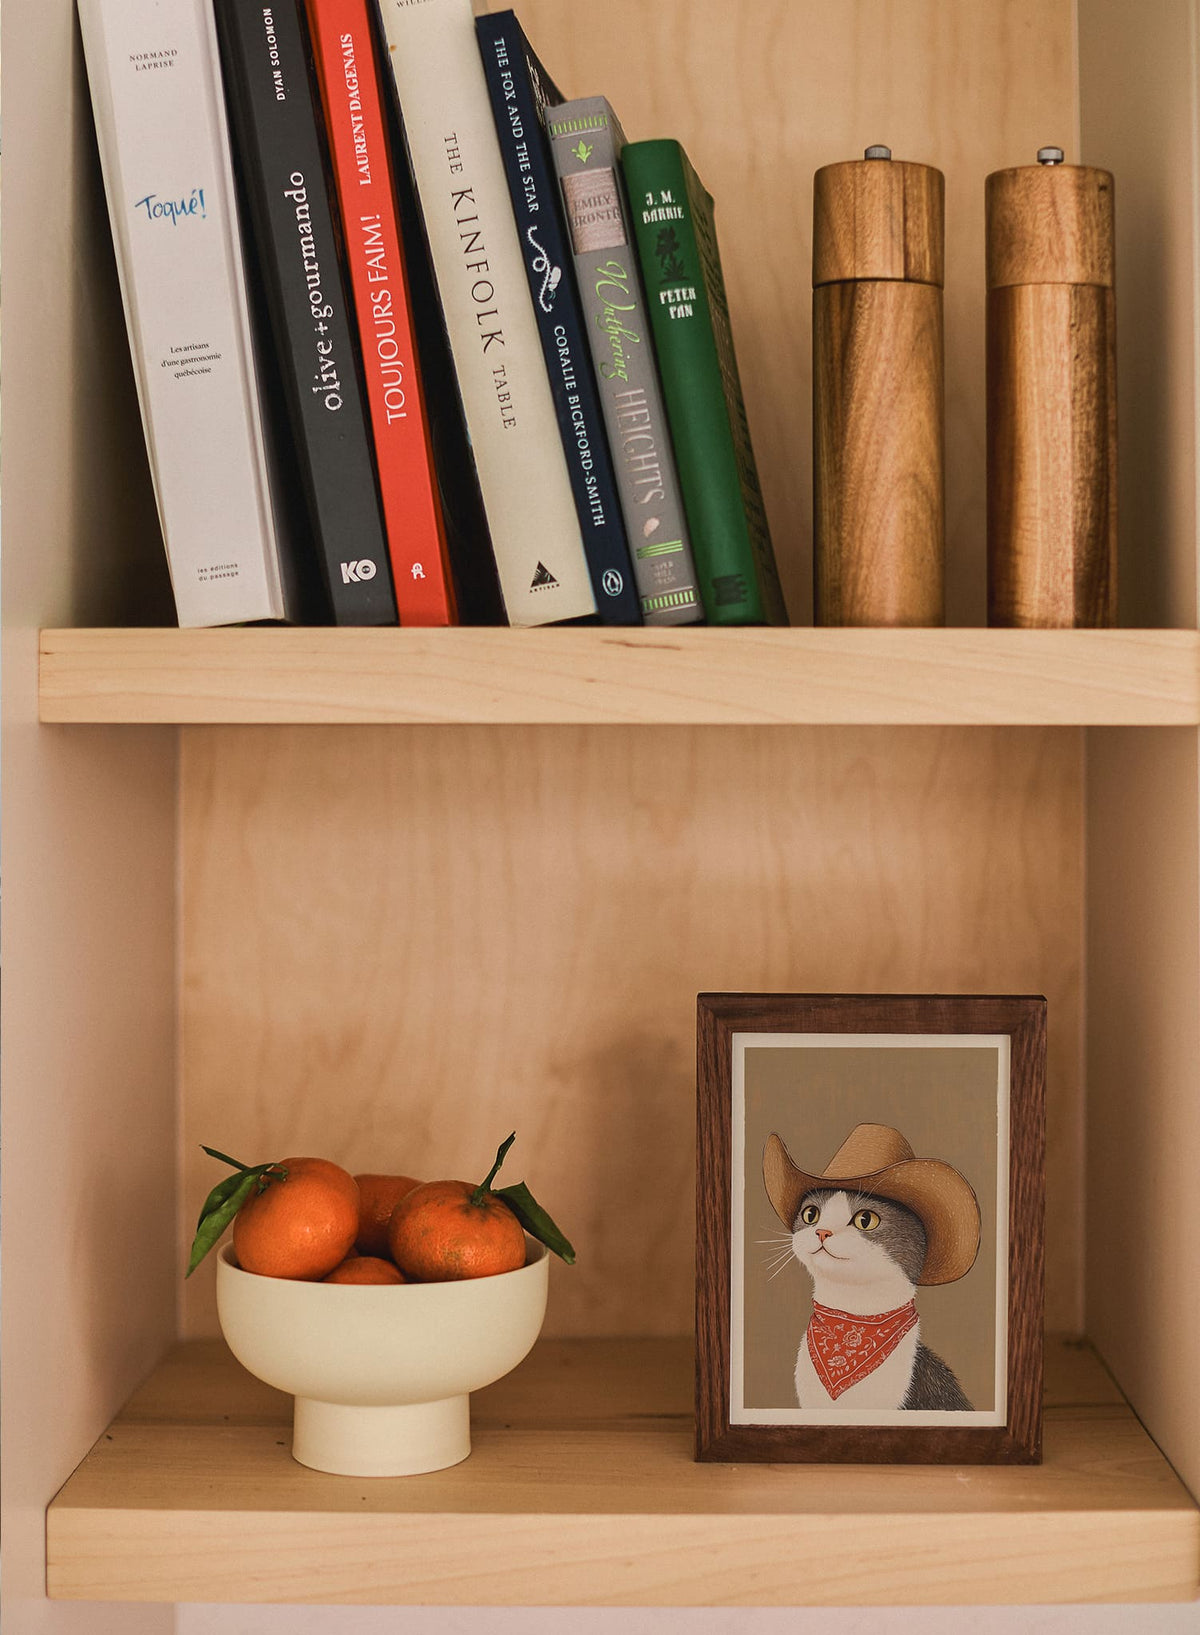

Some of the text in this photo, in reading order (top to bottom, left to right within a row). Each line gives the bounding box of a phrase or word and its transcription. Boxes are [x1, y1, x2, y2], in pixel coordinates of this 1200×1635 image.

[129, 49, 178, 62] NORMAND
[262, 8, 286, 101] DYAN SOLOMON
[135, 60, 174, 71] LAPRISE
[340, 33, 372, 186] LAURENT DAGENAIS
[494, 37, 540, 213] THE FOX AND THE STAR
[574, 194, 612, 212] EMILY
[645, 189, 676, 206] J. M.
[135, 189, 206, 226] Toqué!
[642, 206, 684, 224] BARRIE
[443, 132, 517, 429] THE KINFOLK TABLE
[659, 287, 697, 305] PETER
[360, 213, 407, 425] TOUJOURS FAIM!
[668, 303, 693, 320] PAN
[595, 261, 640, 383] Wuthering
[170, 343, 210, 354] Les artisans
[180, 352, 222, 367] gastronomie
[174, 367, 212, 380] québécoise
[553, 325, 606, 527] CORALIE BICKFORD-SMITH
[614, 388, 665, 505] HEIGHTS
[210, 571, 239, 581] passage
[340, 559, 376, 584] KO
[529, 583, 561, 594] ARTISAN
